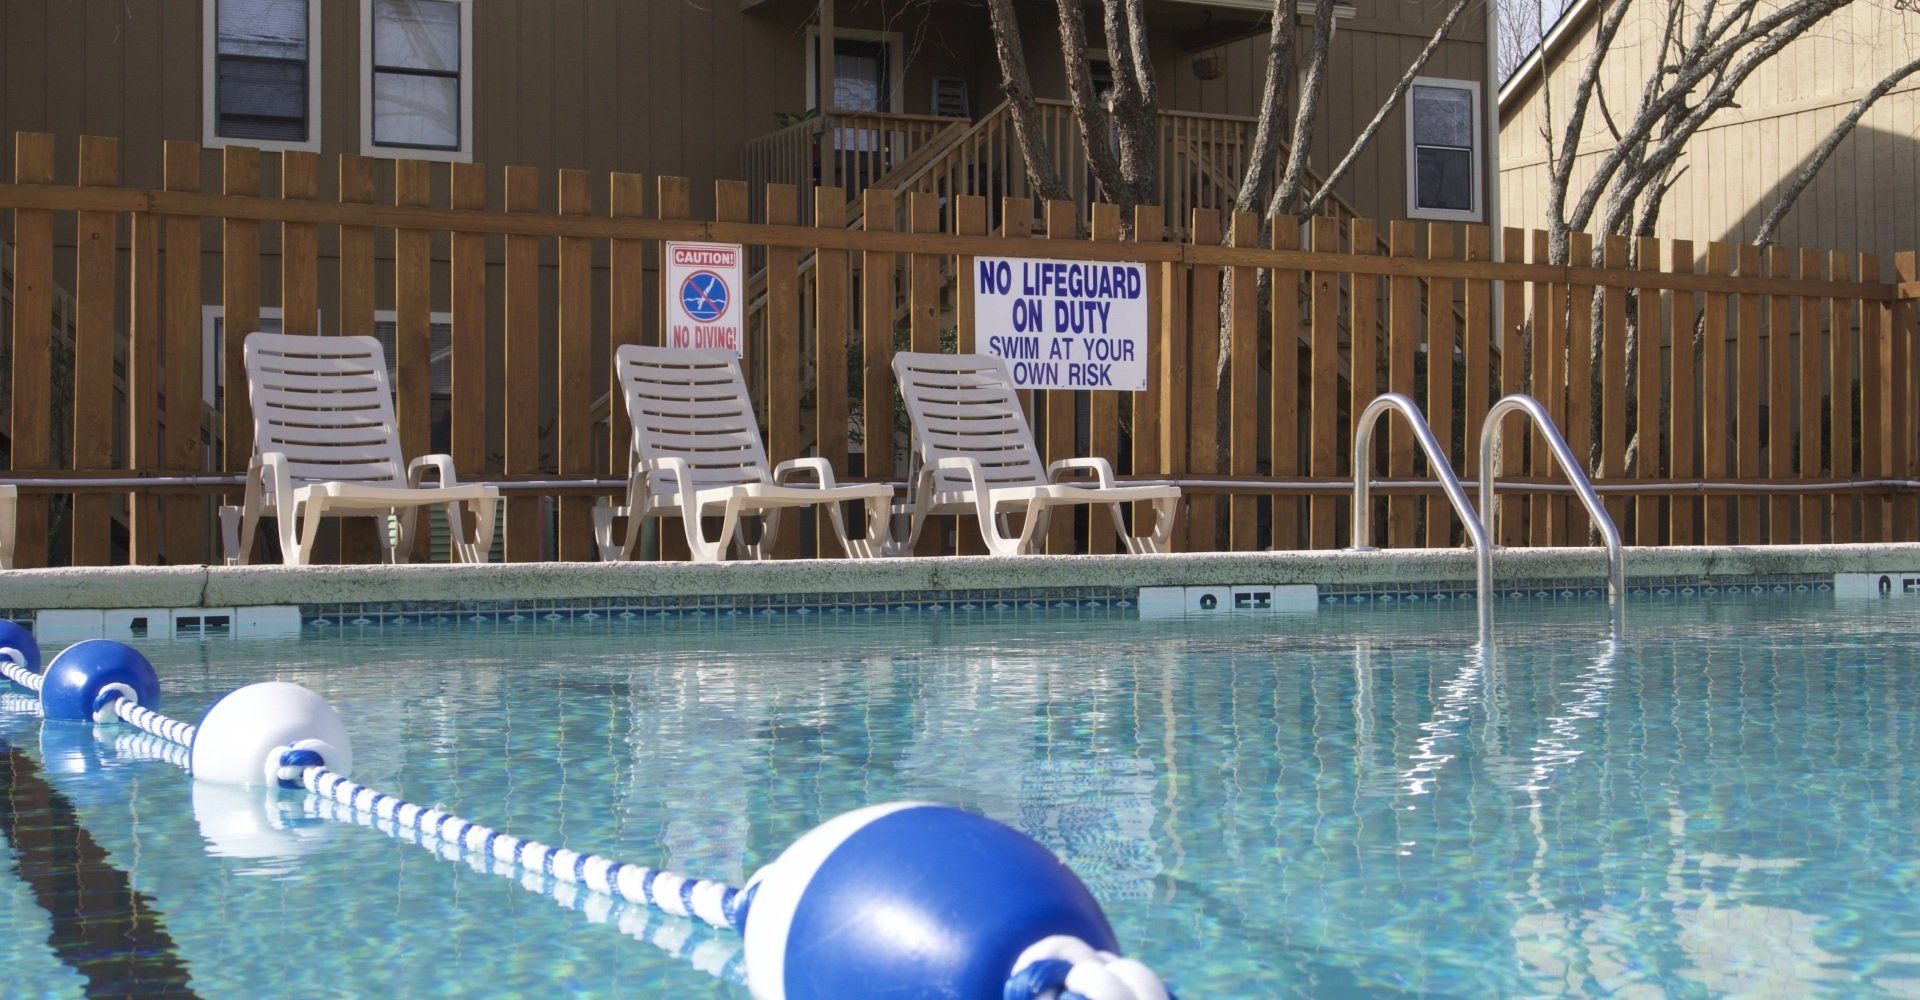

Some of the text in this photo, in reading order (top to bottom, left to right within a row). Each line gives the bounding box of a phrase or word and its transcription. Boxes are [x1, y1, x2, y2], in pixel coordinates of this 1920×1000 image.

[675, 251, 735, 265] CAUTION!
[980, 260, 1141, 300] NO LIFEGUARD
[1012, 298, 1111, 334] ON DUTY
[673, 325, 737, 351] NO DIVING!
[989, 336, 1135, 362] SWIM AT YOUR
[1013, 362, 1112, 387] OWN RISK
